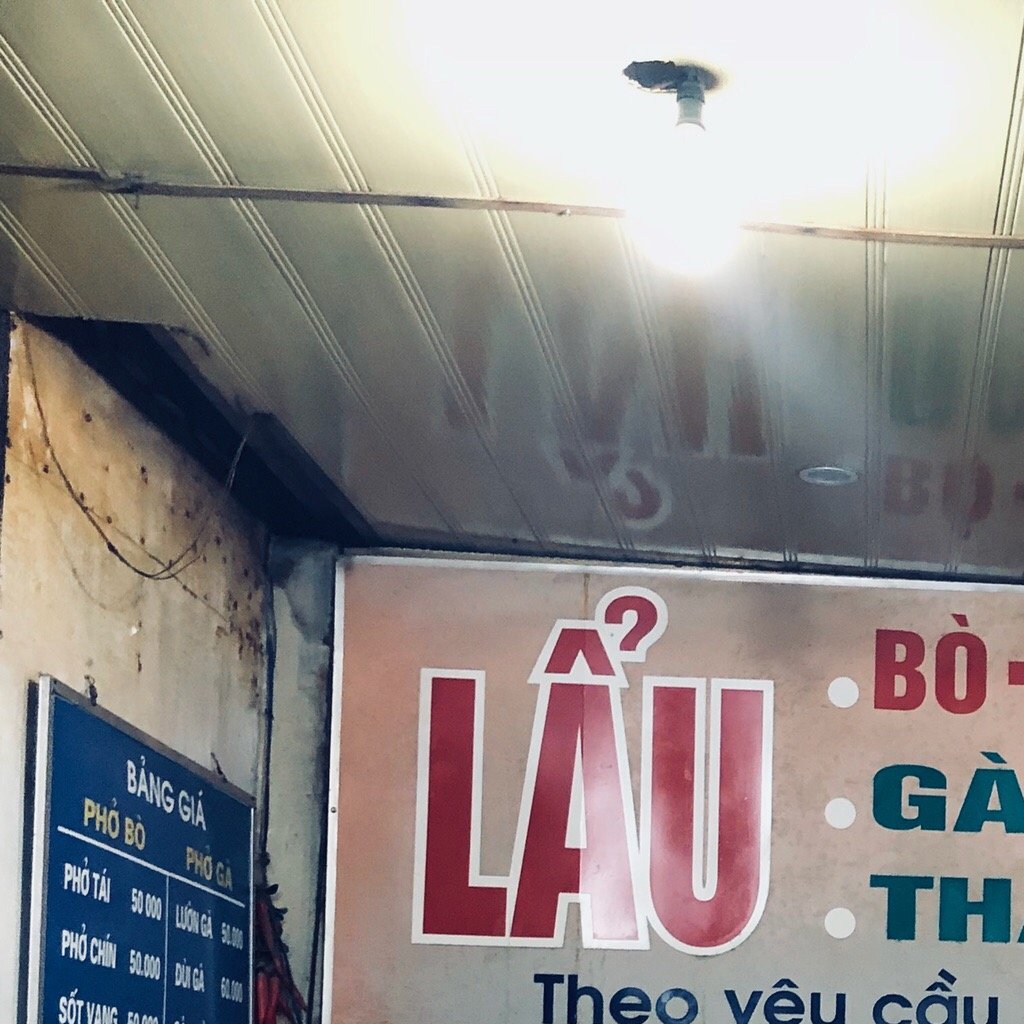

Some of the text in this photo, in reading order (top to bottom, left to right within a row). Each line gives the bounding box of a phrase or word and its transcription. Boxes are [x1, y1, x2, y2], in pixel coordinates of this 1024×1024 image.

[872, 614, 988, 716] BÒ
[126, 755, 207, 831] BẢNG GIÁ
[411, 586, 774, 956] LẨU
[83, 798, 146, 850] PHỞ BÒ
[63, 856, 90, 897] PHỞ
[92, 868, 111, 904] TÁI
[61, 923, 161, 981] PHỞ CHÍN 50.000
